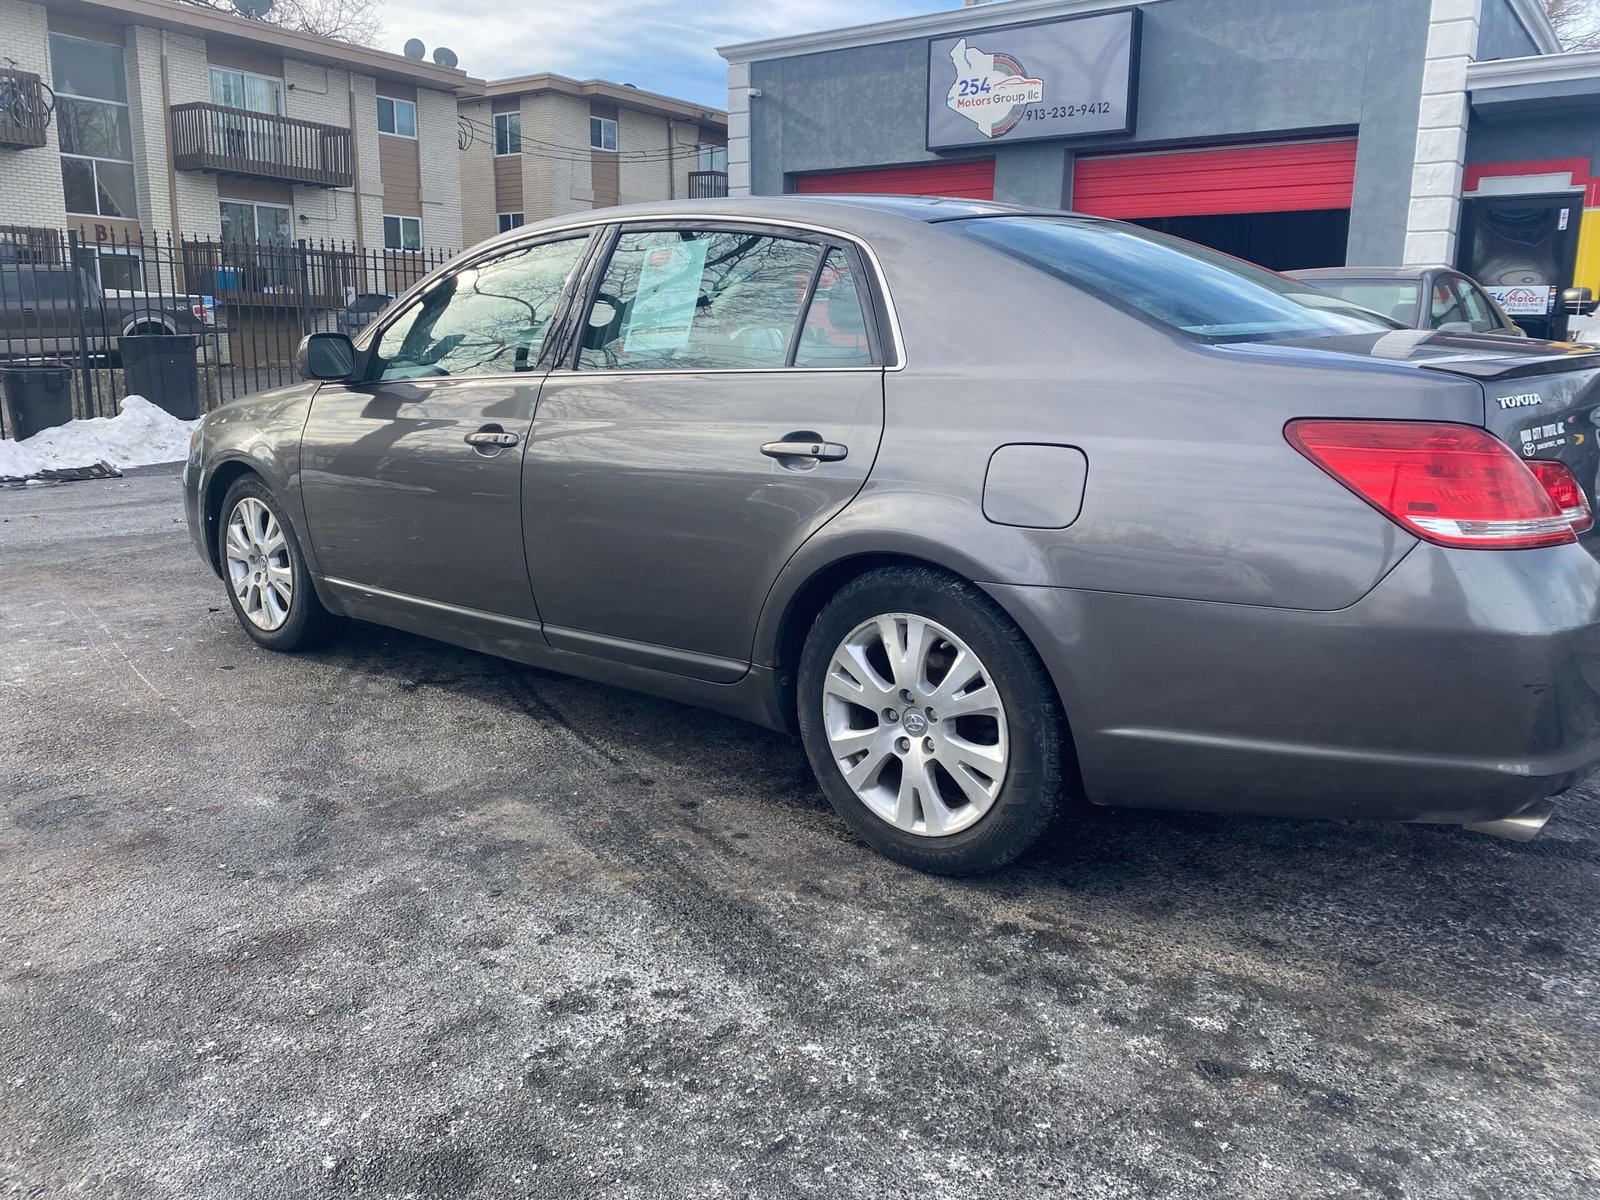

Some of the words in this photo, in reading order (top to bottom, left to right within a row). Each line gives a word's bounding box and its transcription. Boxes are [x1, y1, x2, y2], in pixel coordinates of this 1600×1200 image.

[959, 77, 991, 96] 254
[957, 97, 992, 108] Motors
[993, 93, 1025, 104] Group
[1026, 102, 1110, 121] 913-232-9412
[94, 223, 108, 241] B
[1496, 393, 1542, 409] TOYOTA
